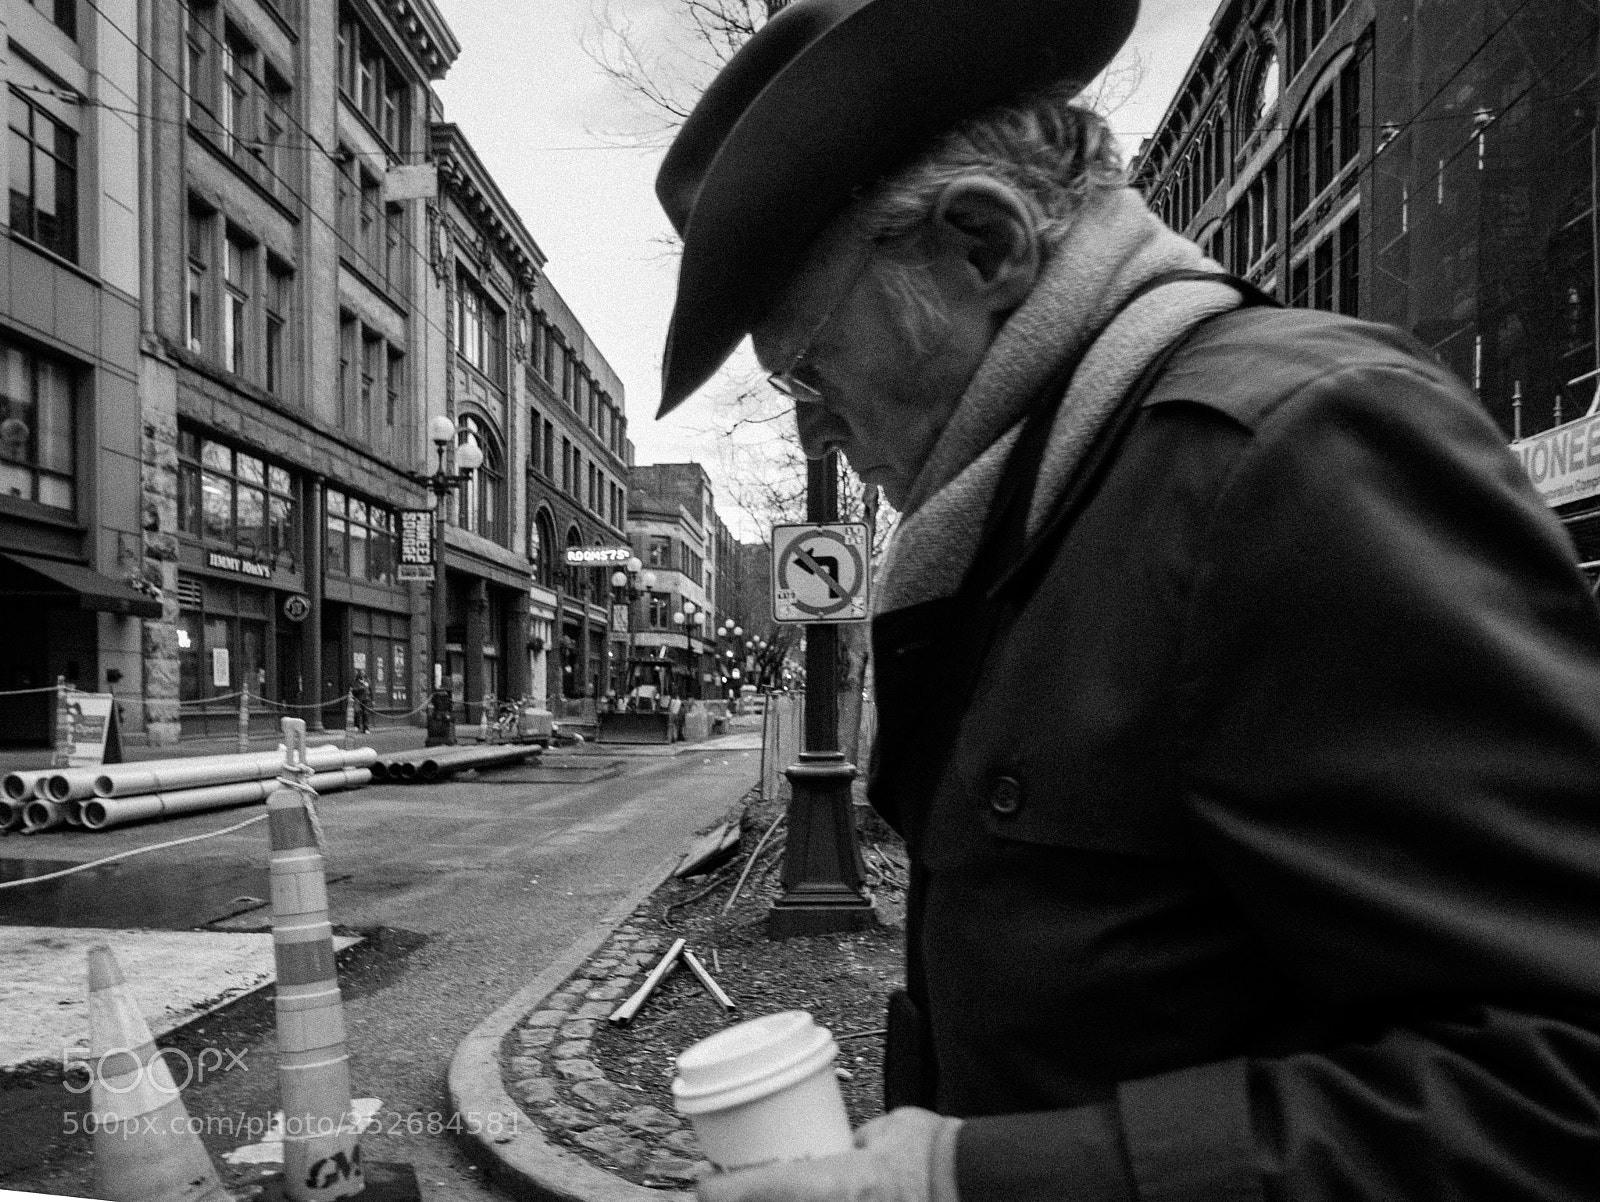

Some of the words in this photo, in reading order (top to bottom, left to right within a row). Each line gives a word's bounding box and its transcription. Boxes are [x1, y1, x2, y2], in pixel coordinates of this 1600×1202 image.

[402, 512, 416, 563] SQUARE
[210, 553, 240, 571] JIMMY
[242, 560, 270, 578] JOHN'S
[567, 550, 608, 562] ROOMS
